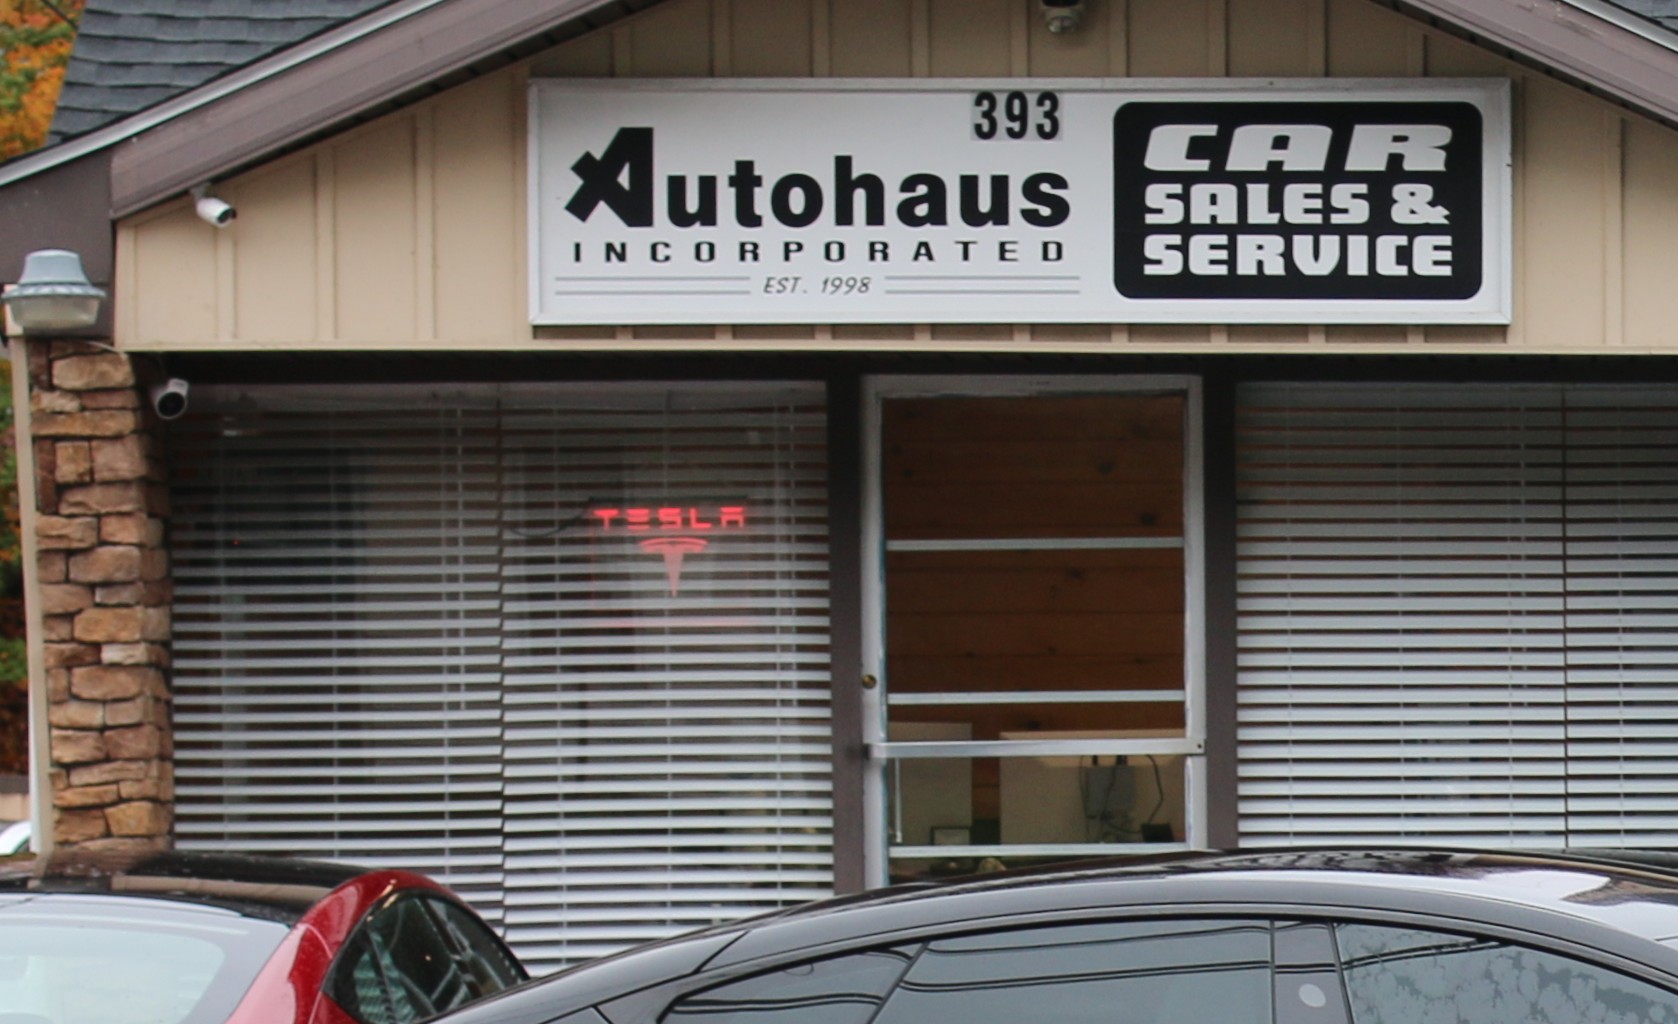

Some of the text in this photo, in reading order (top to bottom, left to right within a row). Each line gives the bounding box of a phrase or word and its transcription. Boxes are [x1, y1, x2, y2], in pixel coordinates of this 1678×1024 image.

[973, 90, 1060, 140] 393
[1143, 124, 1454, 172] CAR
[564, 127, 1071, 228] Autohaus
[1143, 183, 1451, 225] SALES &
[573, 240, 1065, 262] INCORPORATED
[1143, 234, 1453, 276] SERVICE
[763, 277, 873, 295] EST. 1998
[593, 506, 745, 531] TESLA
